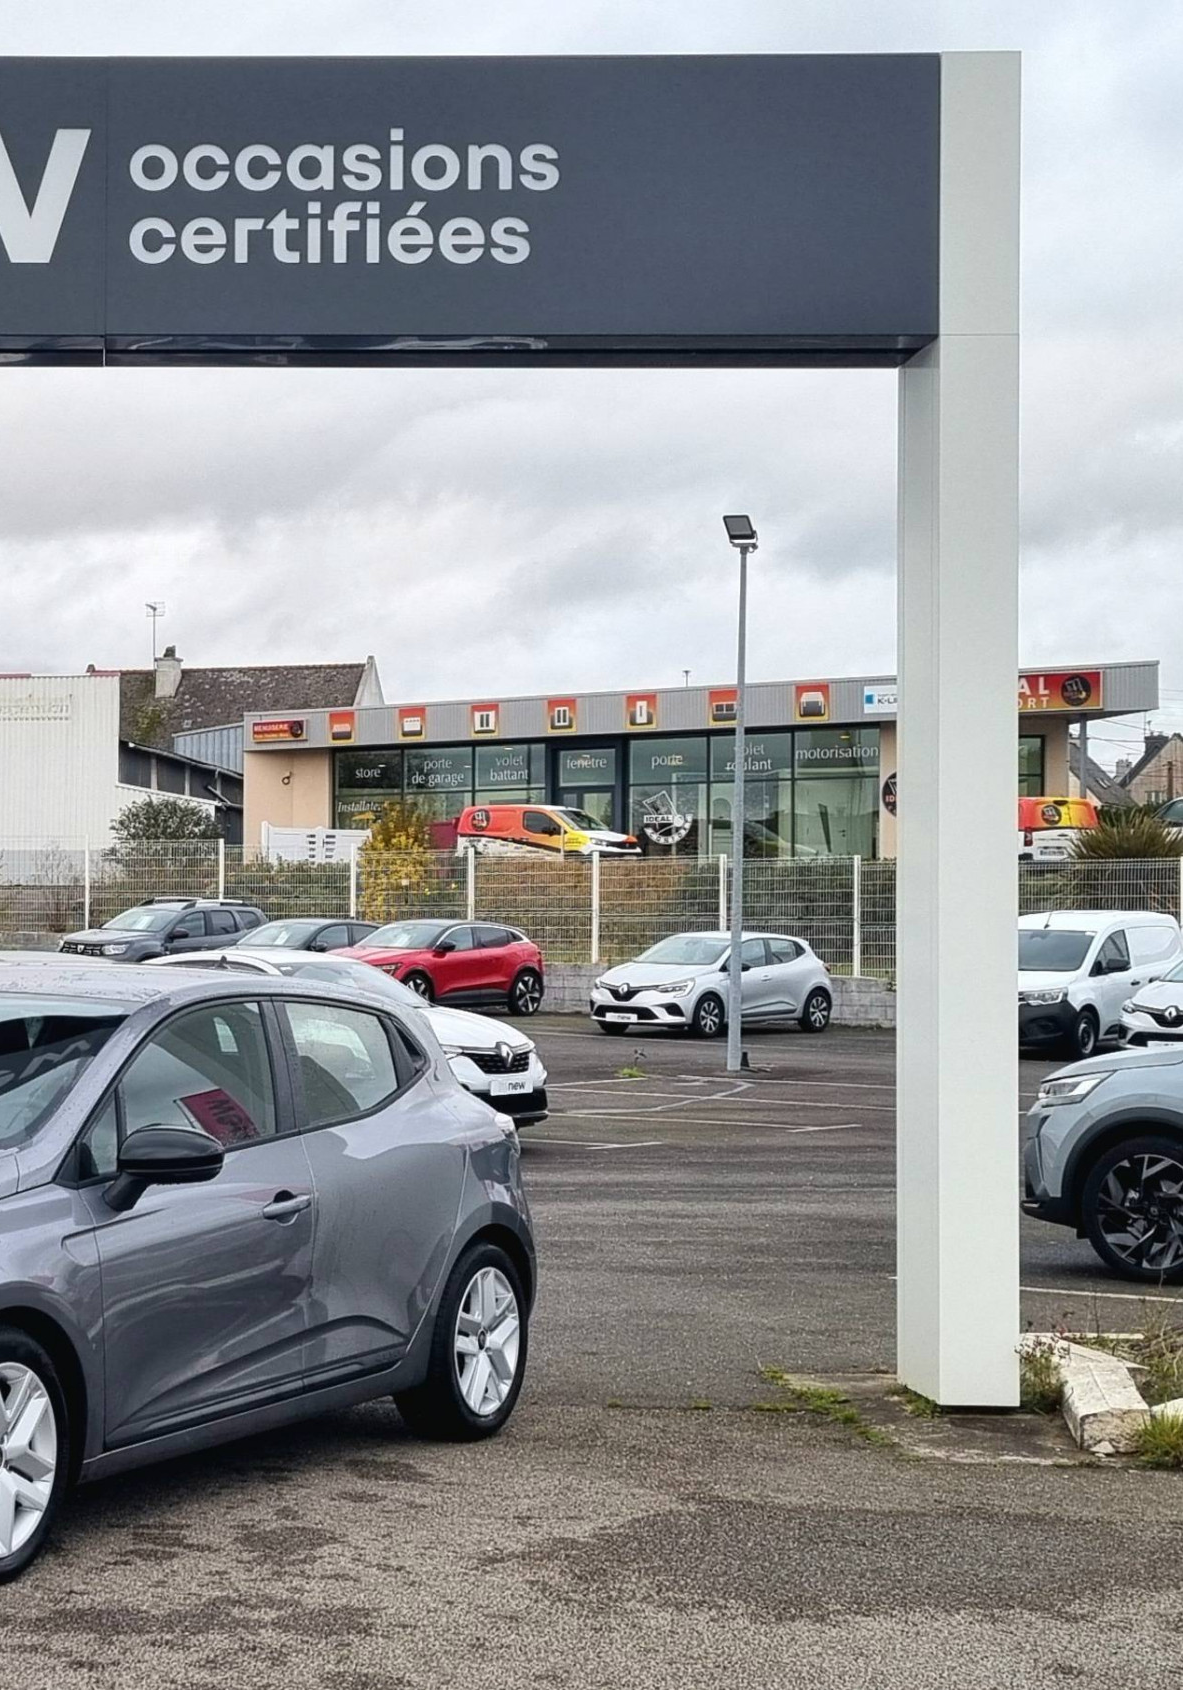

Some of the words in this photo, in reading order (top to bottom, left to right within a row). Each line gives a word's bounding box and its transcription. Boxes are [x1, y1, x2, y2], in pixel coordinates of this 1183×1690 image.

[129, 128, 560, 191] occasions
[129, 201, 531, 264] certifiées
[734, 743, 765, 755] olet
[796, 744, 879, 760] motorisation
[423, 759, 452, 773] porte
[496, 753, 524, 766] volet
[651, 755, 684, 770] porte
[355, 767, 381, 778] store
[411, 772, 426, 784] de
[428, 772, 465, 787] garage
[490, 768, 529, 781] battant
